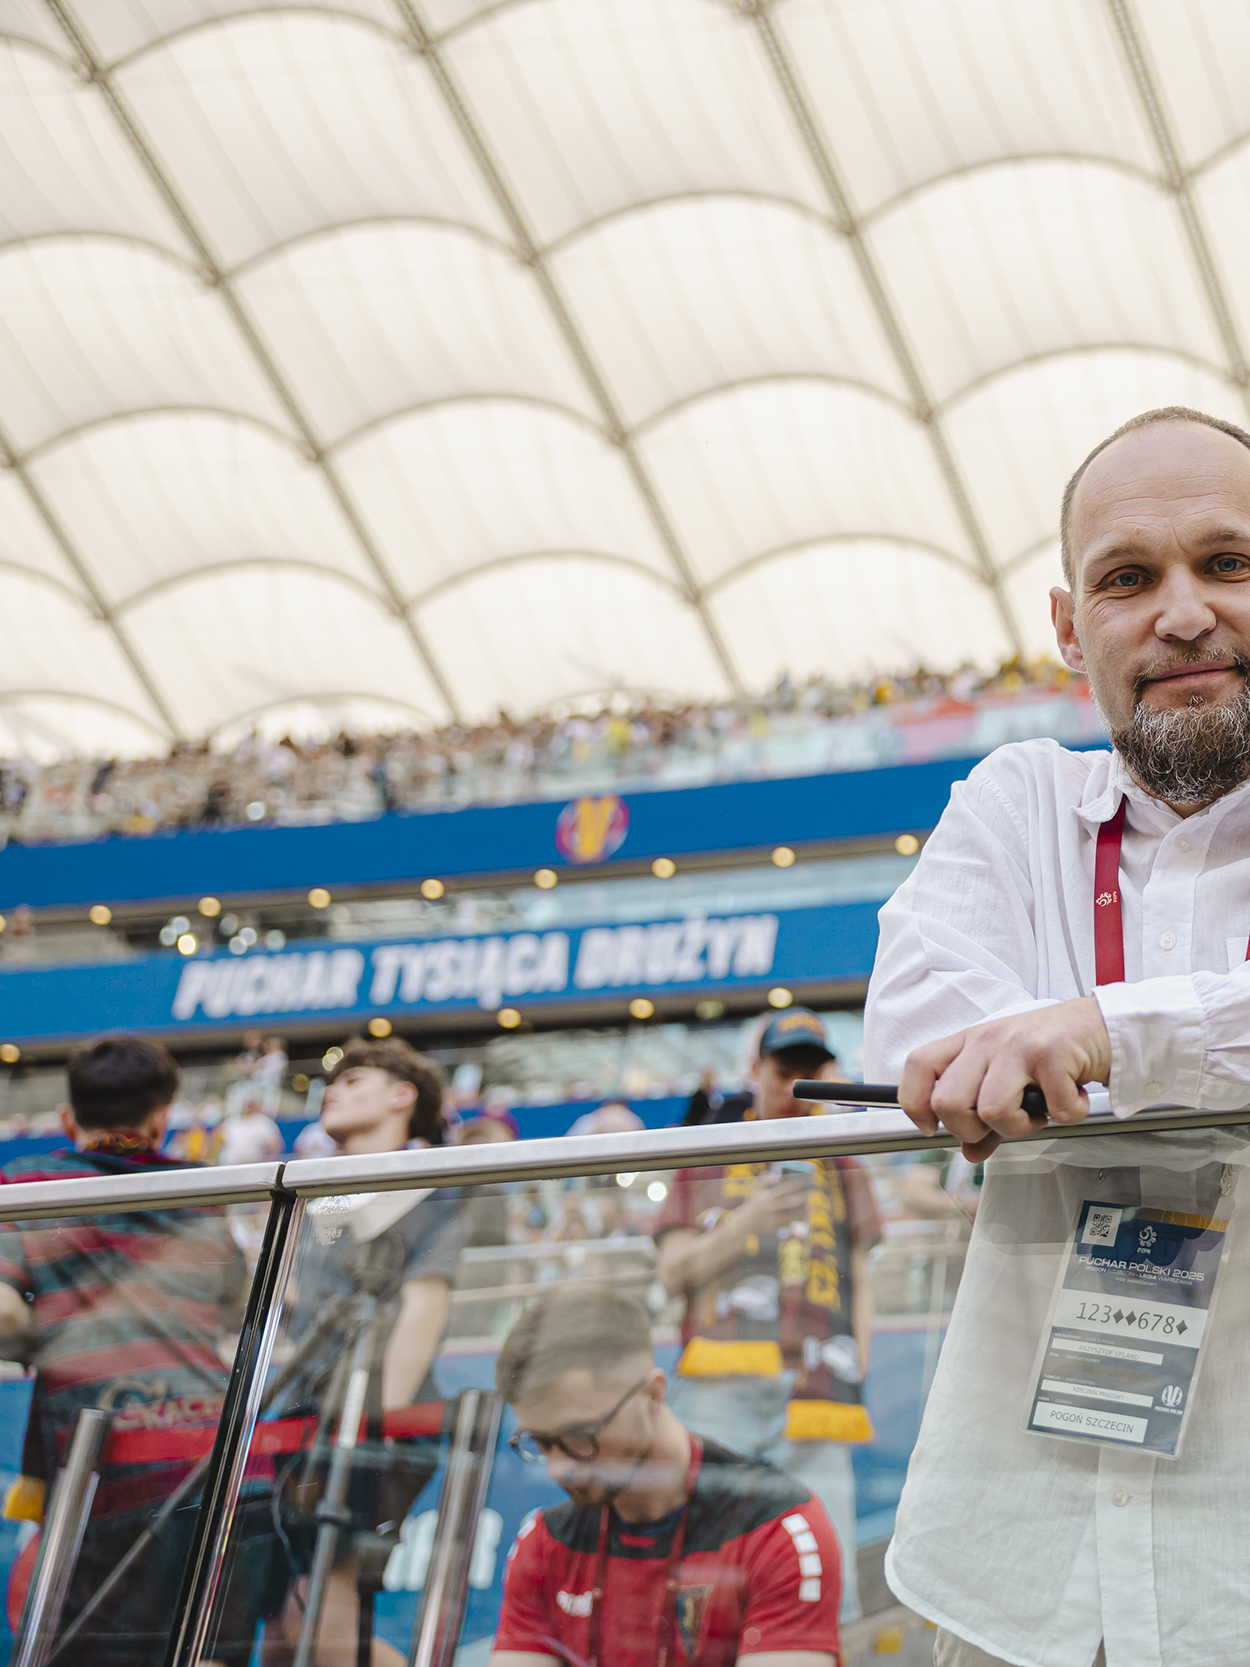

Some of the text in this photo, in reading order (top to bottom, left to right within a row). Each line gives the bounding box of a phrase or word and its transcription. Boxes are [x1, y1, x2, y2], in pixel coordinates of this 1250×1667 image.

[171, 949, 365, 1020] PUCHAR
[1079, 1255, 1126, 1269] PUCHAR
[1129, 1262, 1170, 1276] POLSKI
[1172, 1269, 1205, 1281] 2025
[1079, 1345, 1140, 1361] KRZYSZTOF UFLAND
[1072, 1386, 1125, 1400] RZECZNIK PRASOWY
[1050, 1410, 1134, 1434] POGOŃ SZCZECIN
